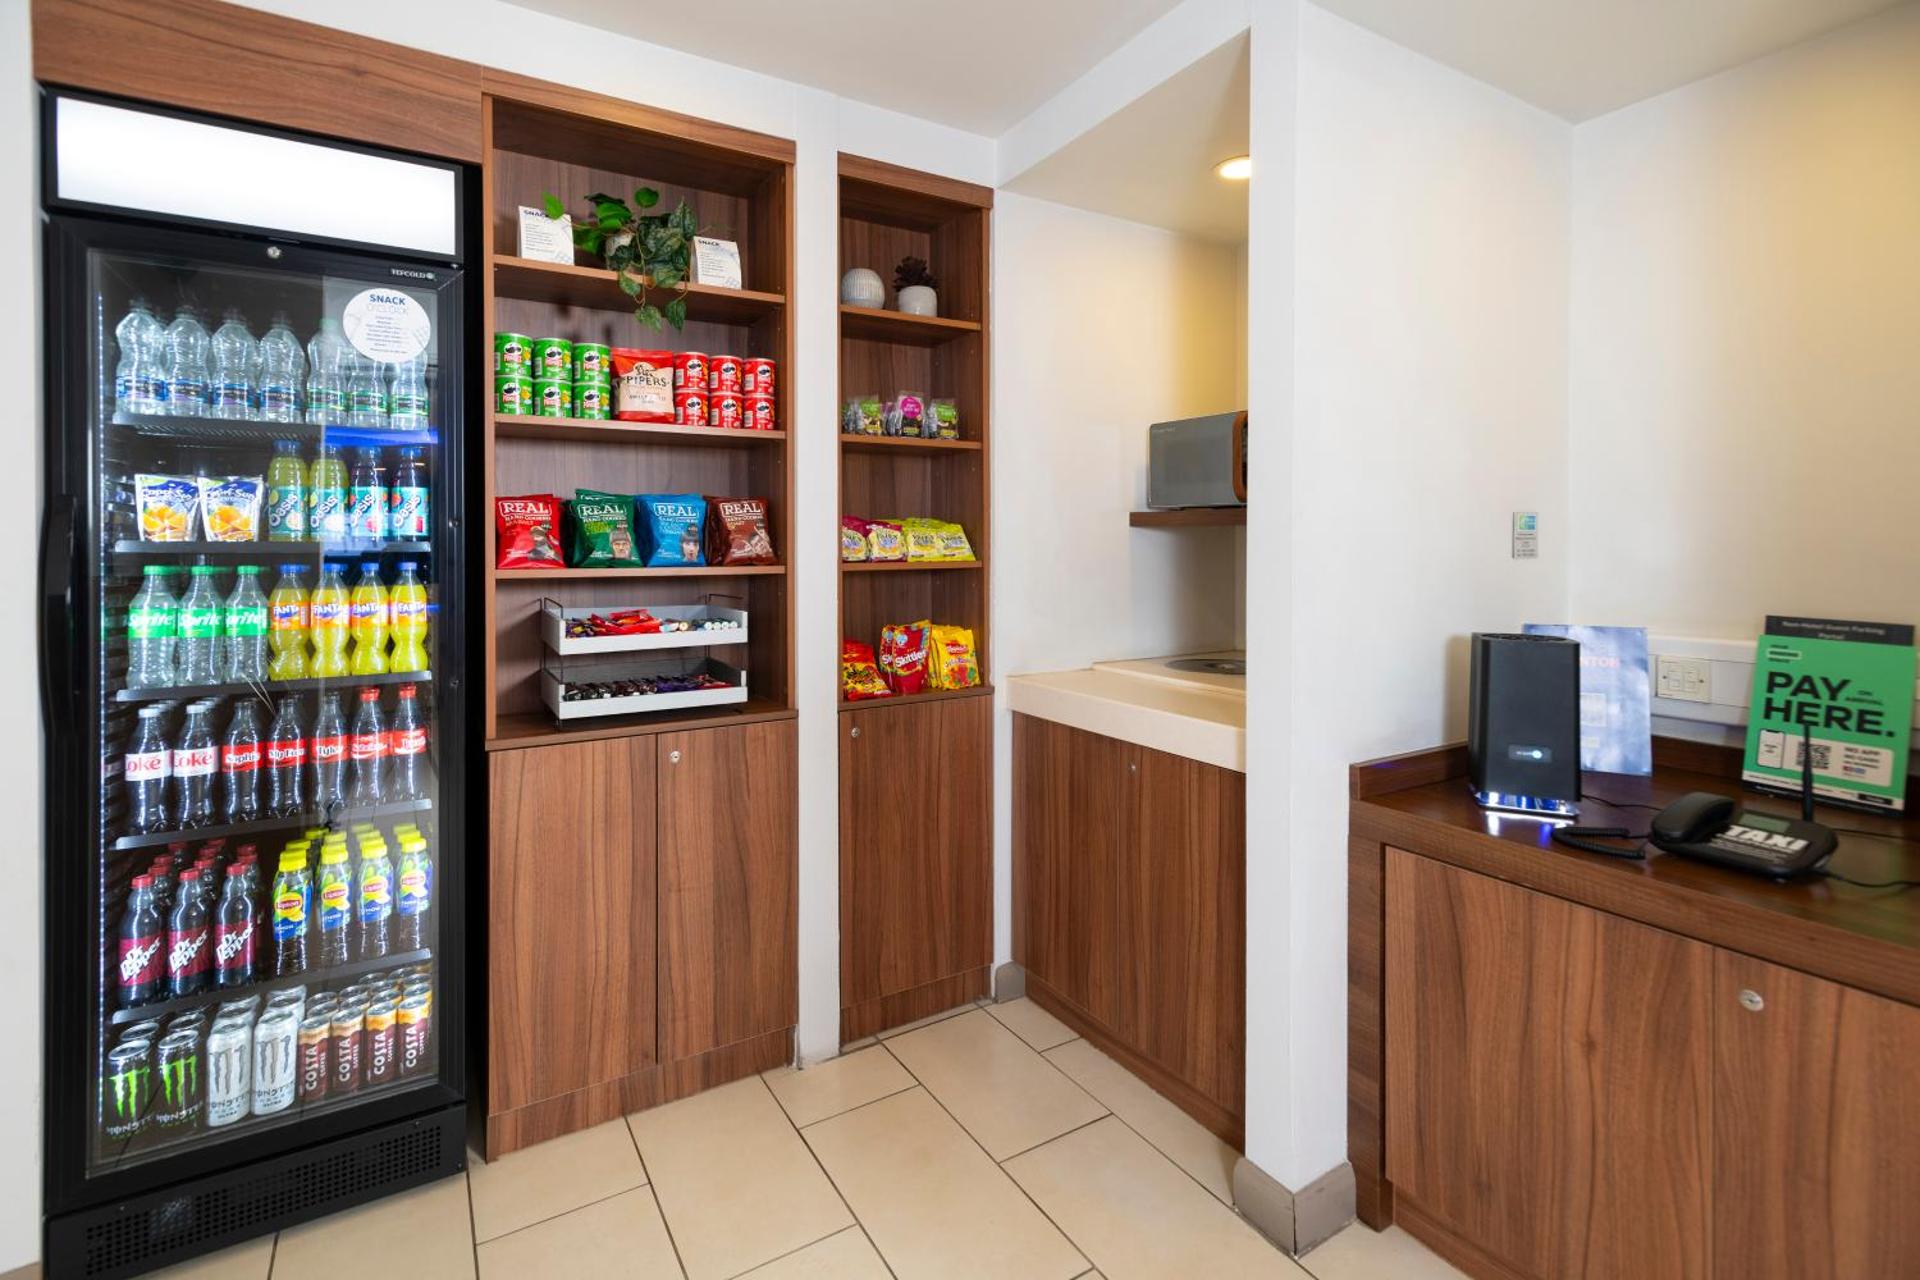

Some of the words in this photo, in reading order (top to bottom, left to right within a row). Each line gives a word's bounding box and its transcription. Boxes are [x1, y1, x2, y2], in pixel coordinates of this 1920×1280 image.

[369, 293, 406, 306] SNACK
[626, 375, 667, 387] PIPERS
[310, 495, 338, 528] Oasis
[393, 495, 421, 527] Oasis
[503, 502, 549, 514] REAL
[582, 504, 624, 516] REAL
[656, 505, 697, 517] REAL
[724, 502, 762, 515] REAL
[895, 649, 927, 667] Skittles
[1766, 671, 1852, 701] PAY
[1763, 697, 1895, 738] HERE.
[1725, 824, 1811, 851] TAXI
[339, 1038, 351, 1082] COSTA
[374, 1032, 386, 1075] COSTA
[406, 1026, 418, 1068] COSTA
[306, 1046, 317, 1091] COSTA
